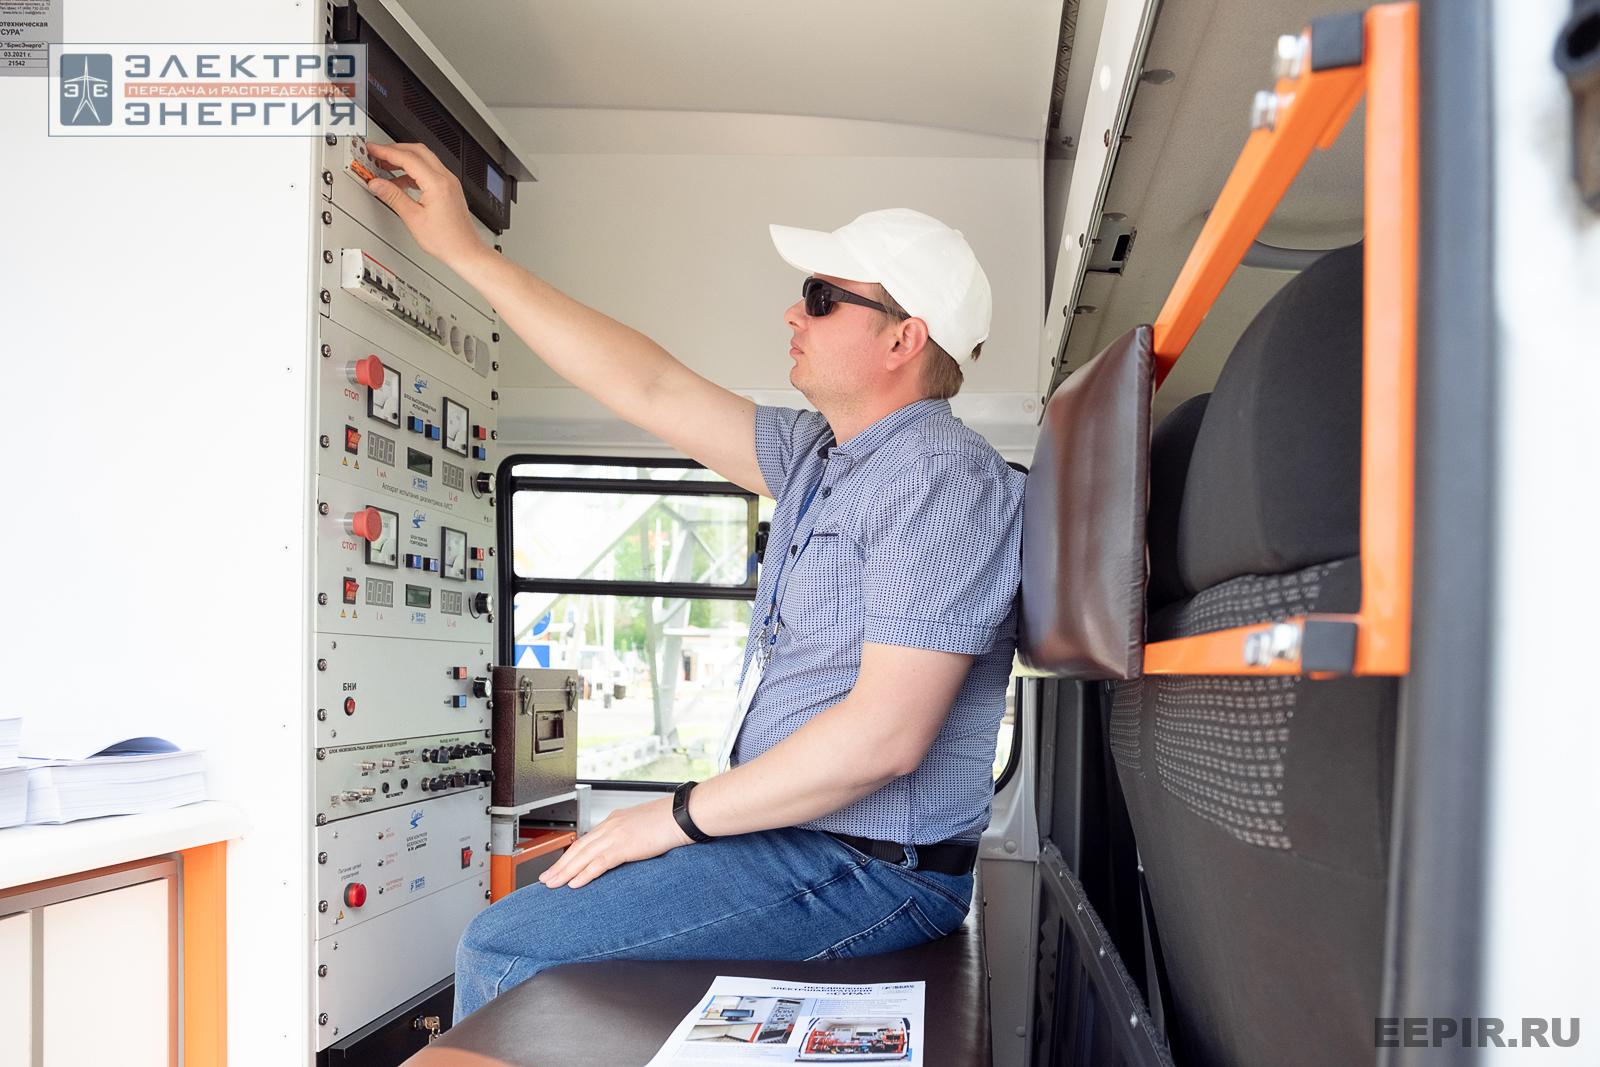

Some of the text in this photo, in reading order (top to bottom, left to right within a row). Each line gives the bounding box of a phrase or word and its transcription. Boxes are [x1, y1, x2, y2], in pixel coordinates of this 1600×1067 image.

[344, 388, 360, 402] СТОП
[342, 541, 358, 552] СТОП
[342, 682, 357, 692] БНИ
